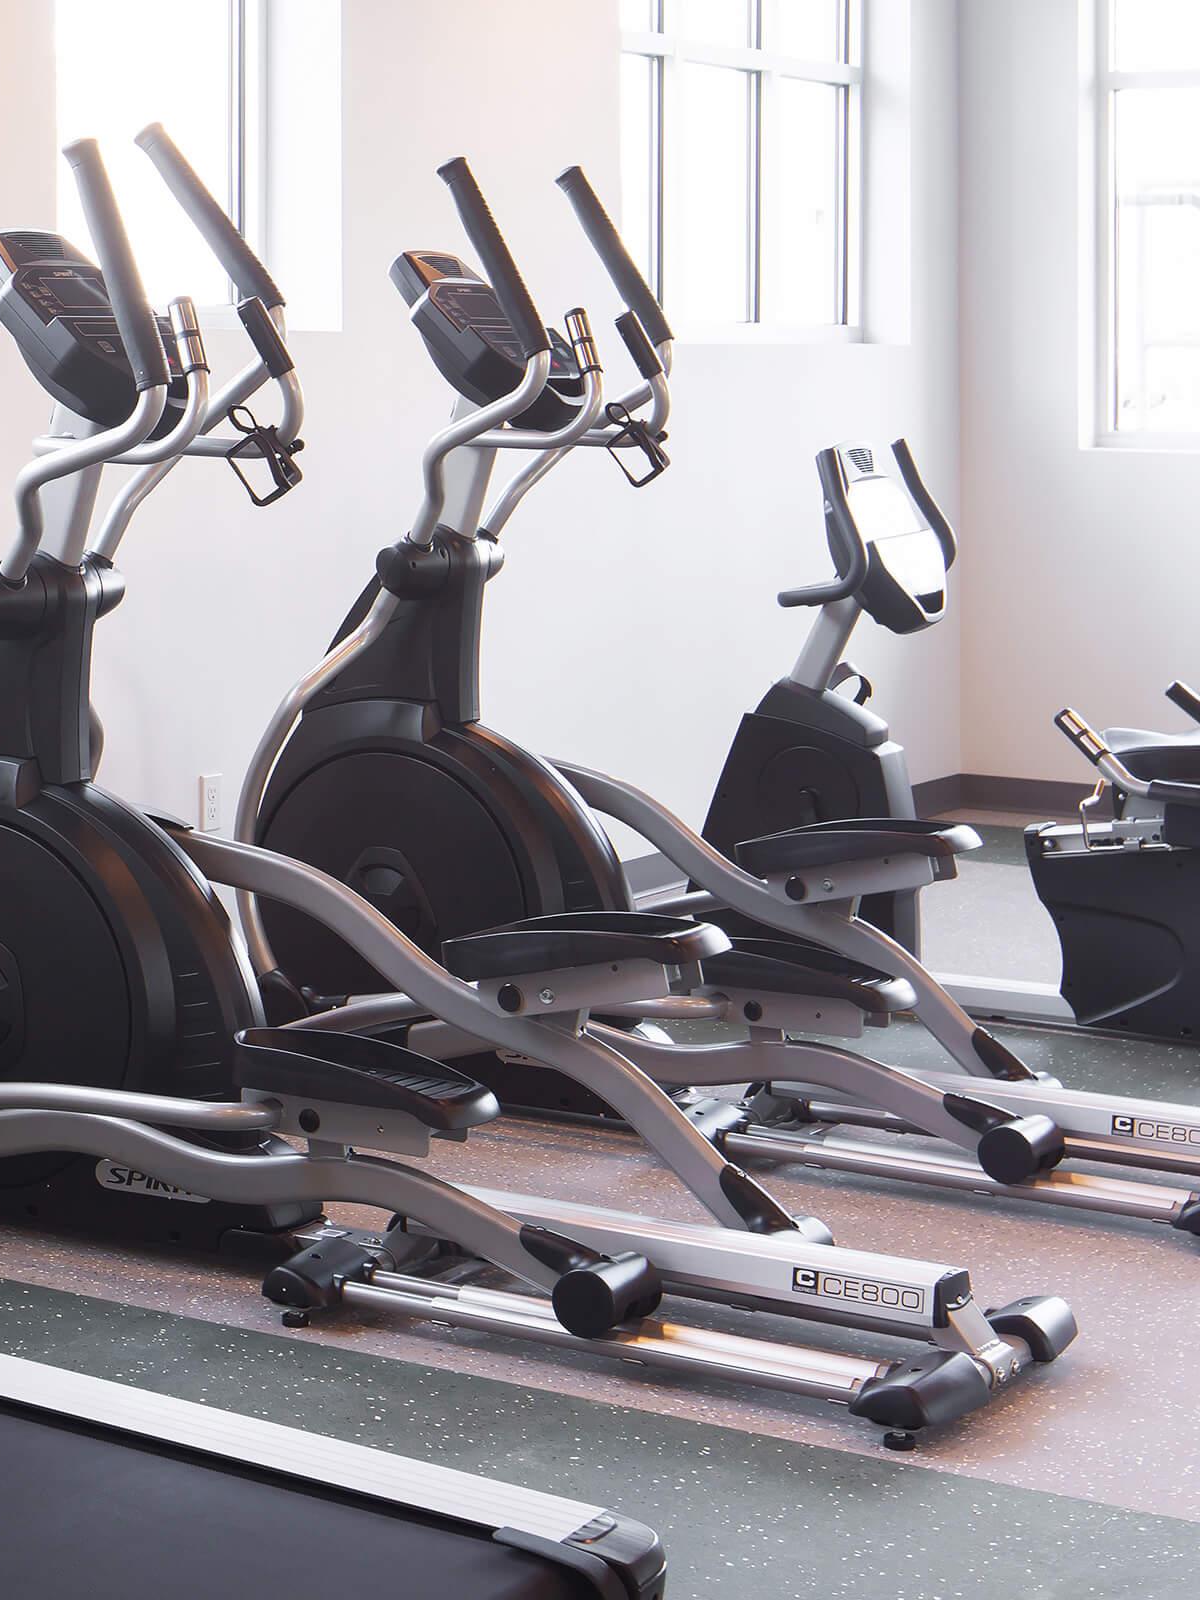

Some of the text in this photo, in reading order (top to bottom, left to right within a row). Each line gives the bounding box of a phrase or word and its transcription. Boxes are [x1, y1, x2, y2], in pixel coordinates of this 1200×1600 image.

[1114, 1116, 1131, 1131] C
[795, 1269, 920, 1309] C CE800
